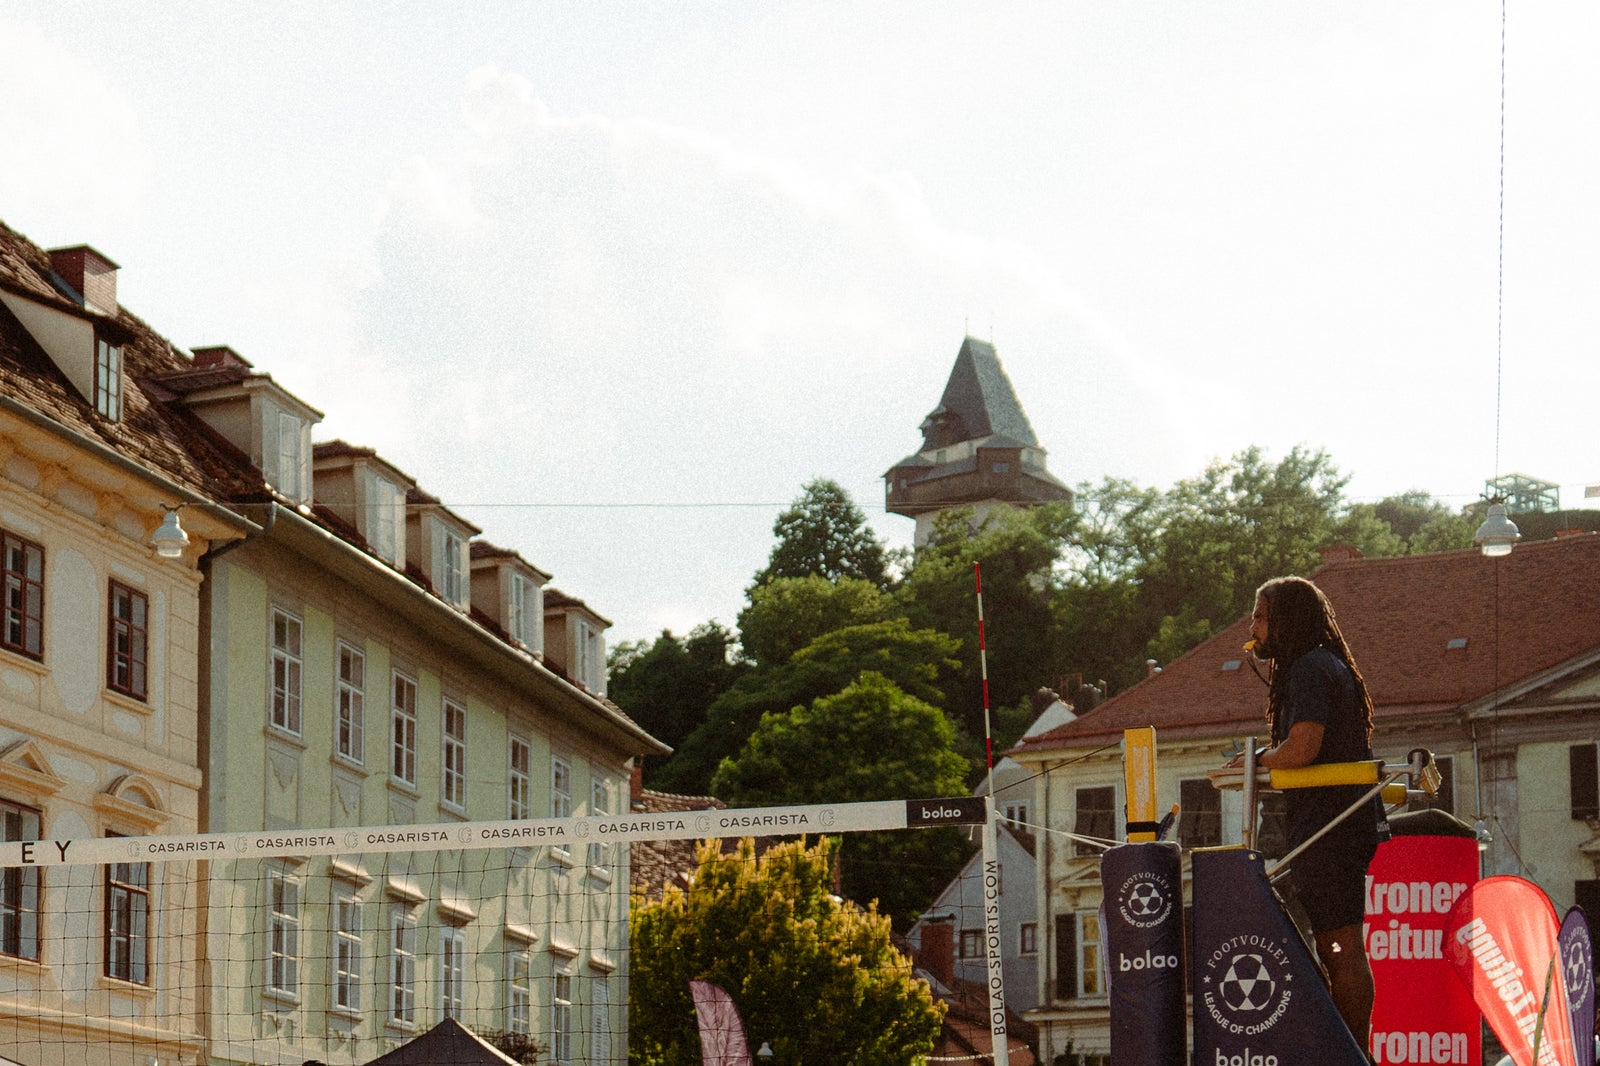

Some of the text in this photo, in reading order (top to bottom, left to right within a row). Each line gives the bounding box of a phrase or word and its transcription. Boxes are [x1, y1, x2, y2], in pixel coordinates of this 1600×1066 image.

[147, 841, 226, 854] CASARISTA
[255, 835, 336, 849] CASARISTA
[366, 831, 449, 844] CASARISTA
[481, 826, 566, 840] CASARISTA
[598, 819, 686, 834] CASARISTA
[719, 813, 809, 828] CASARISTA
[921, 805, 962, 820] bolao
[1120, 871, 1170, 894] FOOTVOLLEY
[1136, 921, 1145, 929] OF
[985, 859, 1006, 1036] BOLAO-SPORTS.COM
[1119, 949, 1178, 972] bolao
[1207, 934, 1290, 968] FOOTVOLLEY
[1203, 989, 1292, 1035] LEAGUE OF CHAMPIONS
[1370, 1030, 1467, 1065] ronen
